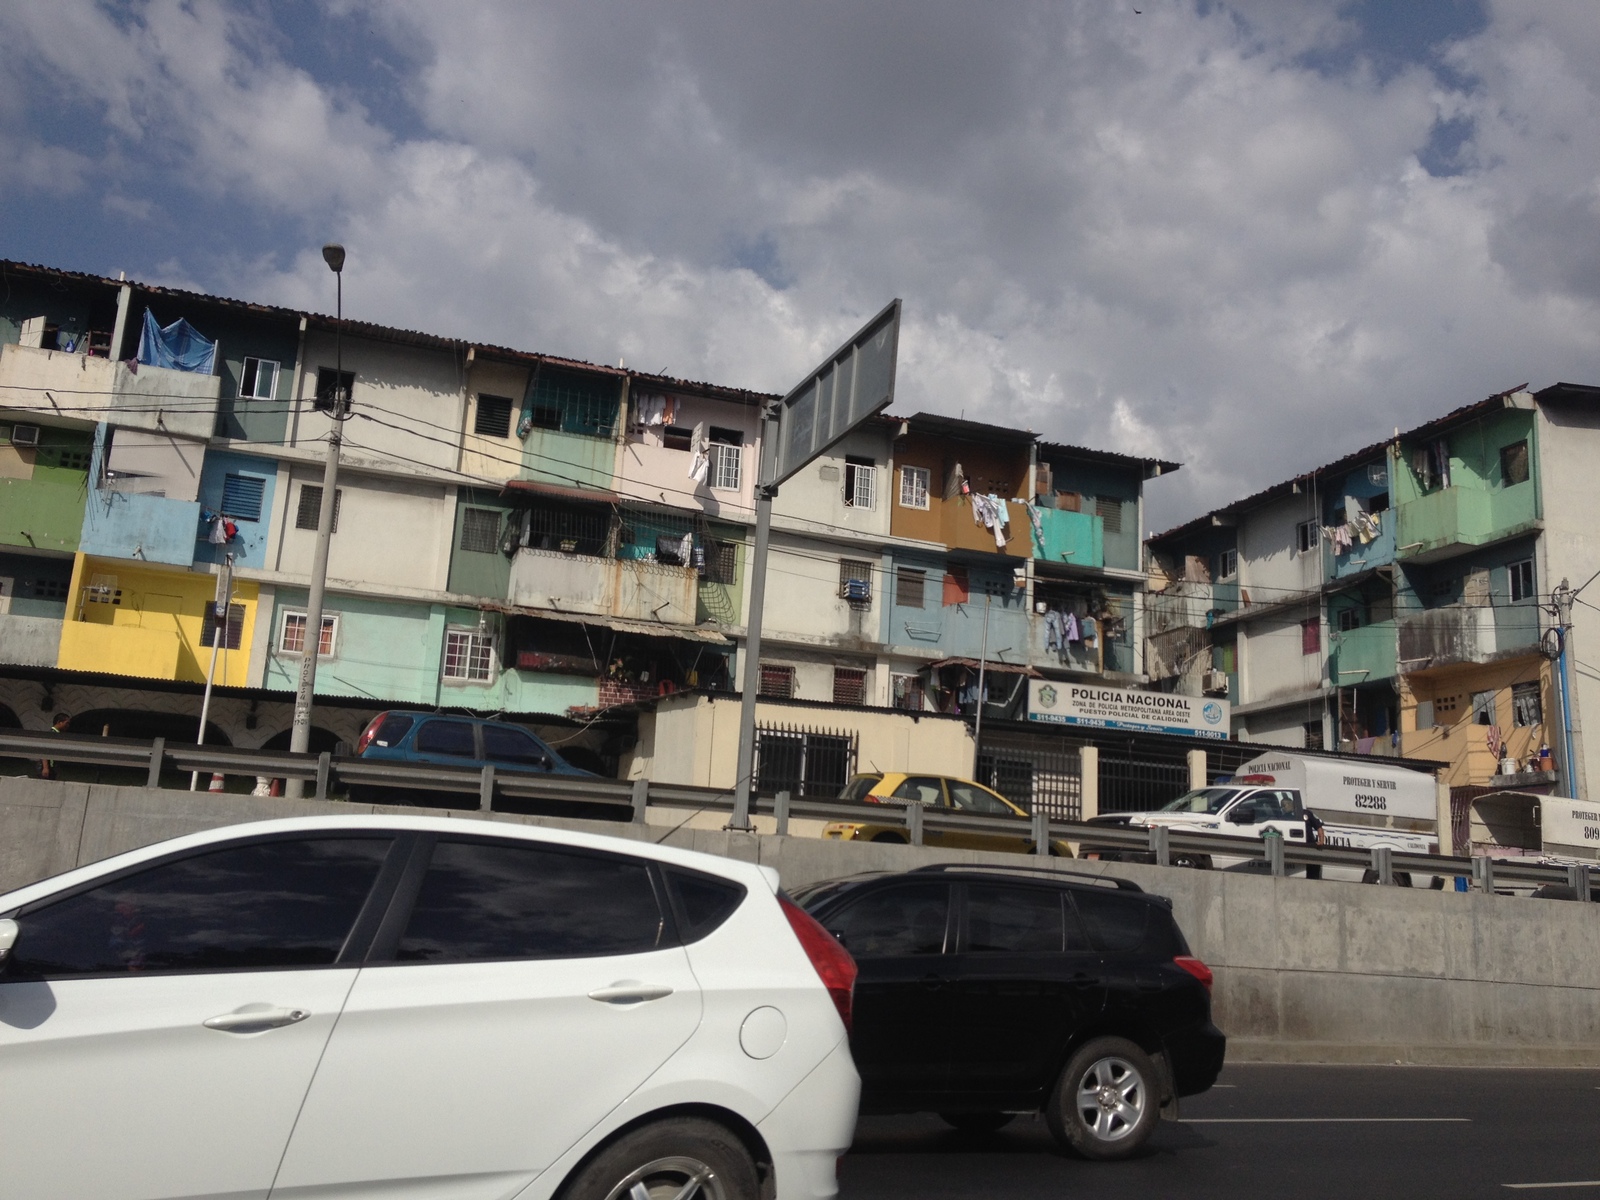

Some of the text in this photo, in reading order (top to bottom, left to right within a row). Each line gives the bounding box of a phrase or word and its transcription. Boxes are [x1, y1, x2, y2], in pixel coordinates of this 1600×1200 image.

[1071, 688, 1191, 710] POLICIA NACIONAL
[1072, 700, 1086, 708] ZONA
[1098, 702, 1119, 710] POLICIA
[1120, 704, 1161, 715] METROPOLITANA
[1162, 709, 1174, 717] AREA
[1175, 710, 1190, 718] OESTE
[1079, 708, 1107, 716] PUESTO
[1108, 711, 1139, 719] POLICIAL
[1151, 715, 1189, 723] CALIDONIA
[1248, 761, 1291, 774] POLICIA NACIONAL
[1342, 775, 1397, 790] PROTEGER Y SERVIR
[1355, 793, 1387, 810] 82288
[1571, 810, 1598, 821] PROTEGER
